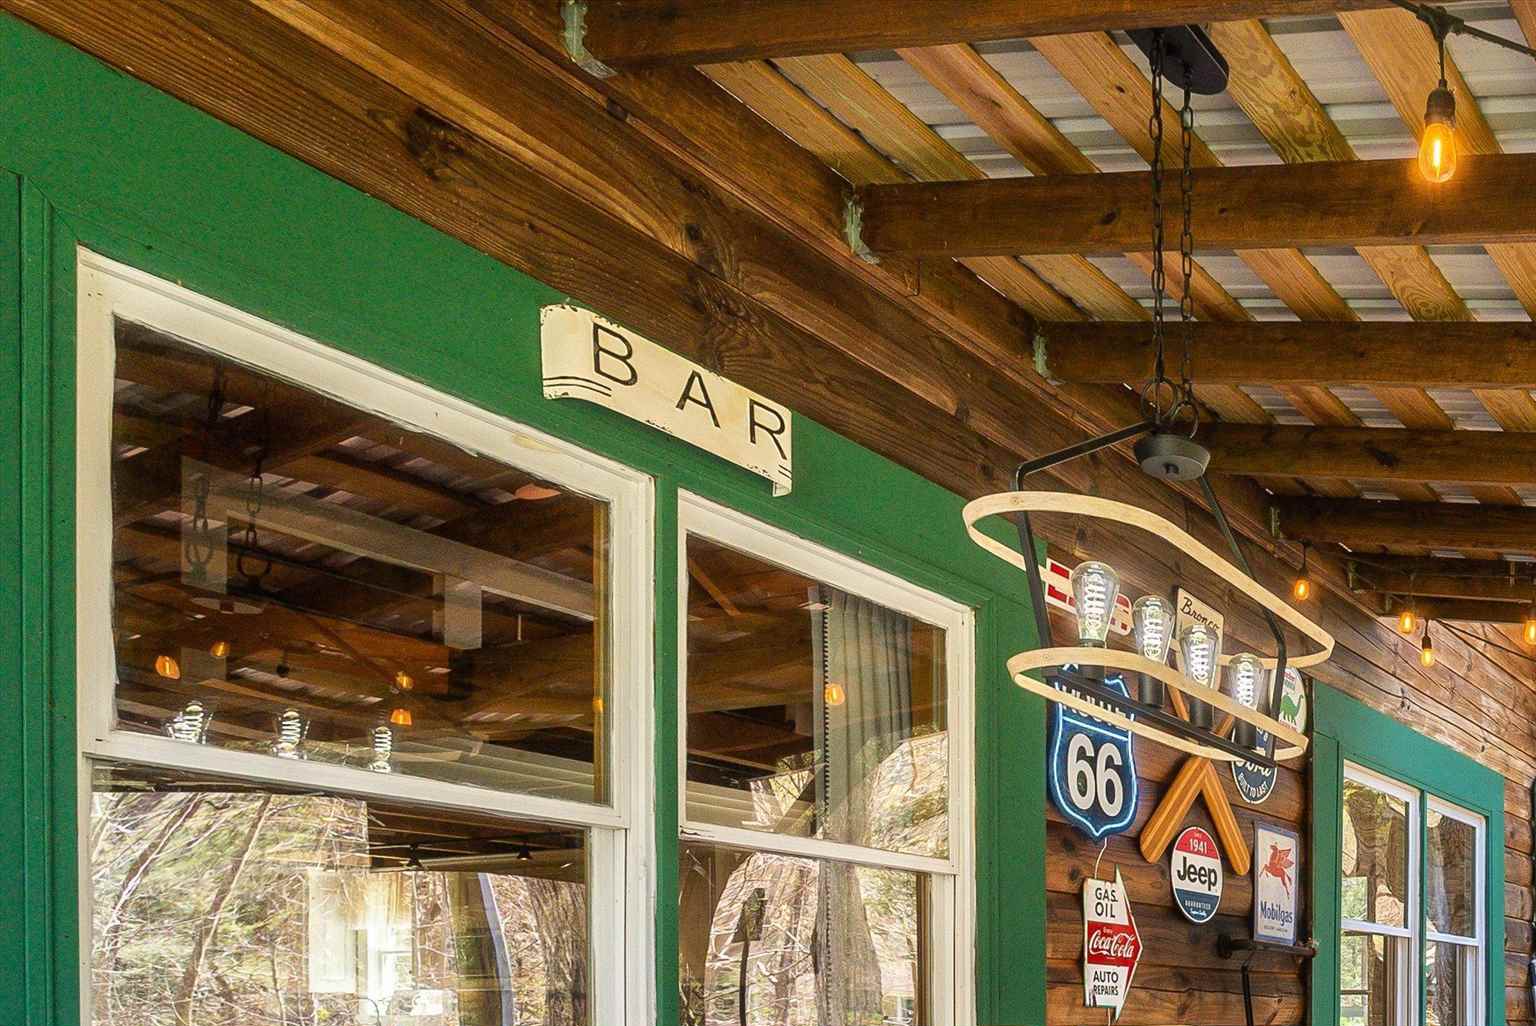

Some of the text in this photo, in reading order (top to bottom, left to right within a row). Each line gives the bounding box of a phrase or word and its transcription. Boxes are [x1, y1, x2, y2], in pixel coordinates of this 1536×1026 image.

[591, 322, 788, 460] BAR
[1067, 733, 1123, 817] 66
[1256, 780, 1269, 798] LAST
[1189, 838, 1208, 855] 1941
[1176, 855, 1218, 892] Jeep
[1095, 902, 1116, 918] OIL
[1260, 900, 1293, 927] Mobilgas
[1093, 971, 1119, 984] AUTO
[1093, 984, 1119, 996] REPAIRS
